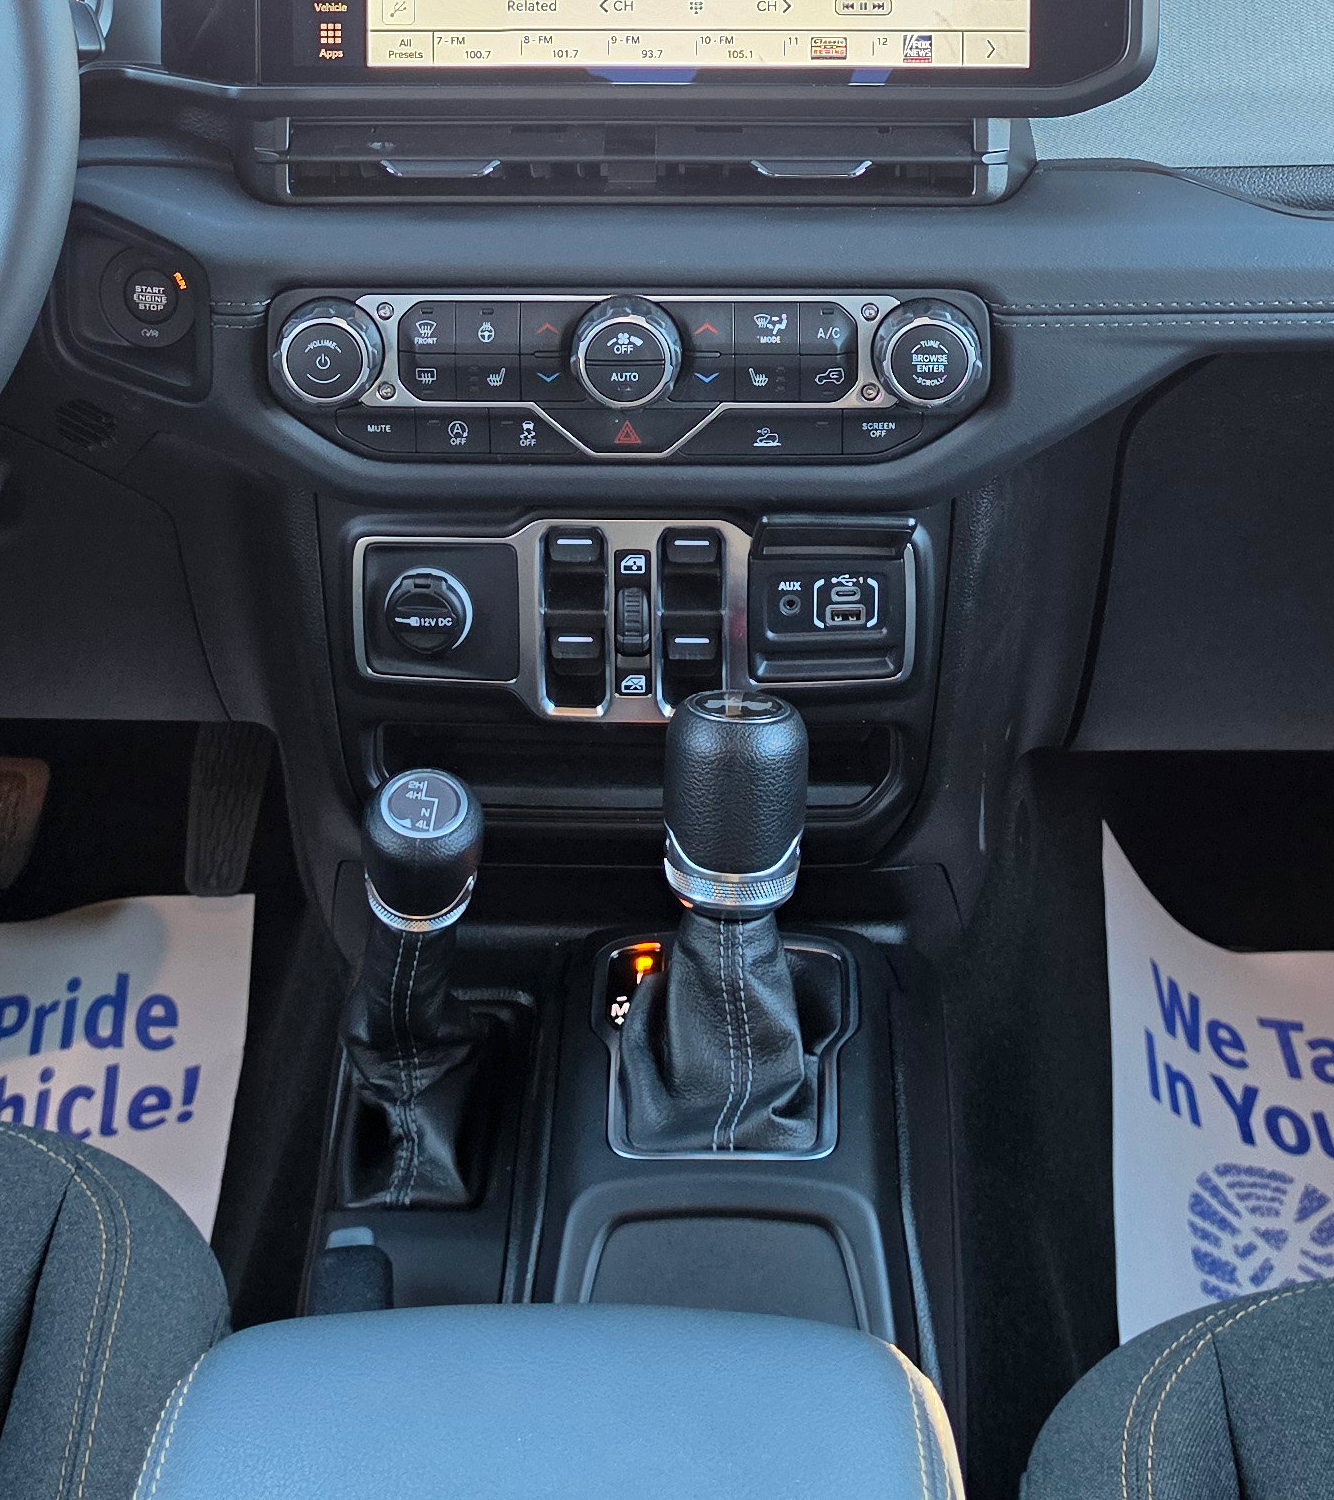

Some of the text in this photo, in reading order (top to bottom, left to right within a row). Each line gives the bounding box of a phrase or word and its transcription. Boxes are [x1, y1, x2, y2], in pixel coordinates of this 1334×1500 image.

[314, 2, 347, 13] Vehicle
[507, 0, 557, 12] Related
[613, 0, 634, 12] CH
[756, 0, 778, 12] CH
[399, 38, 411, 47] All
[451, 36, 465, 45] FM
[538, 36, 553, 44] FM
[626, 36, 640, 44] FM
[699, 36, 734, 45] 10 FM
[788, 37, 799, 45] 11
[877, 37, 888, 46] 12
[319, 48, 343, 59] Apps
[388, 50, 423, 59] Presets
[465, 50, 491, 59] 100.7
[552, 50, 578, 59] 101.7
[641, 50, 663, 59] 93.7
[727, 50, 753, 59] 105.1
[135, 285, 165, 294] START
[133, 293, 167, 303] ENGINE
[138, 303, 164, 311] STOP
[817, 328, 840, 339] A/C
[760, 336, 781, 344] MODE
[920, 340, 940, 348] TUNE
[308, 340, 337, 350] VOLUME
[614, 345, 633, 354] OFF
[912, 354, 947, 363] BROWSE
[916, 365, 944, 373] ENTER
[611, 372, 639, 382] AUTO
[915, 376, 945, 386] SCROLL
[862, 422, 895, 430] SCREEN
[450, 438, 467, 446] OFF
[520, 439, 536, 447] OFF
[778, 581, 801, 591] AUX
[421, 617, 453, 626] 12V DC
[408, 781, 423, 789] 2H
[406, 792, 421, 800] 4H
[421, 808, 430, 817] N
[416, 820, 429, 829] 4L
[611, 1002, 630, 1017] M
[1150, 958, 1249, 1070] We
[1144, 1027, 1203, 1130] In
